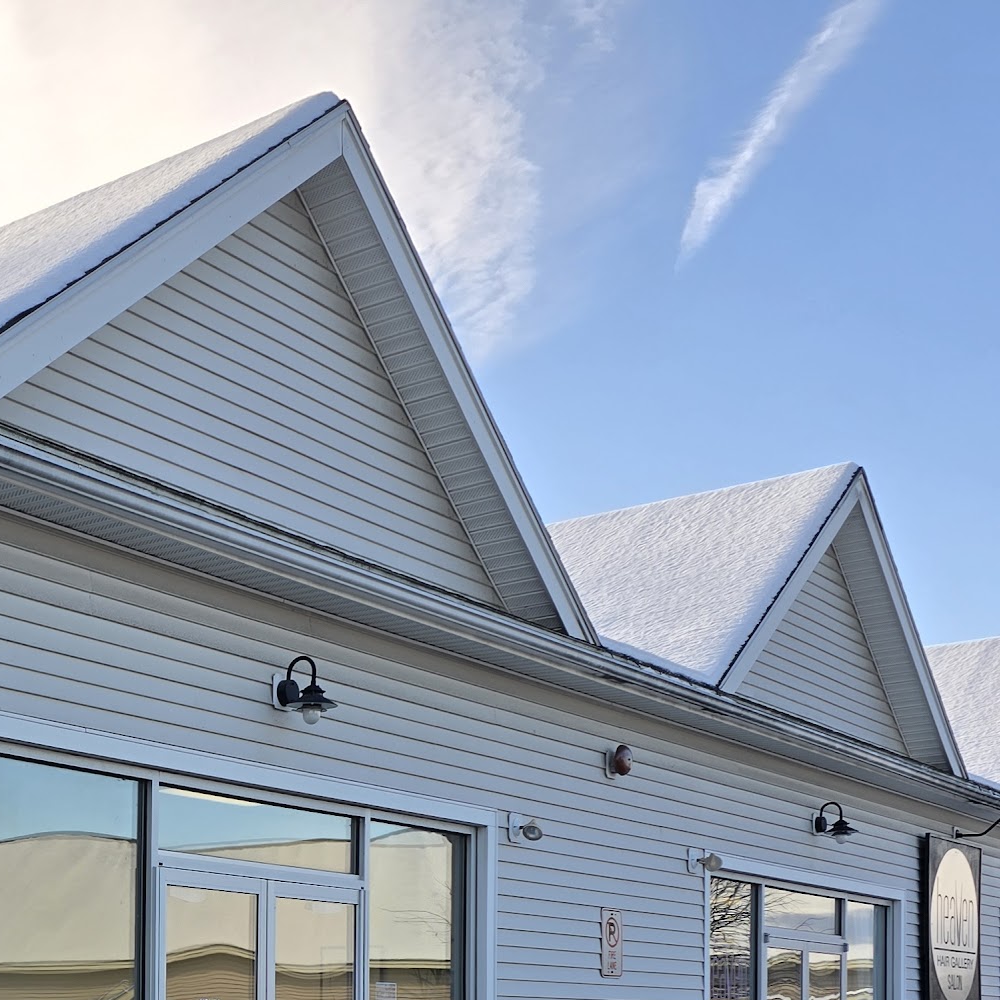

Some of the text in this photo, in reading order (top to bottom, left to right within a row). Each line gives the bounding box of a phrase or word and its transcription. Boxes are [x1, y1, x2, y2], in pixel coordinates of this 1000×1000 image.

[607, 950, 617, 960] FIRE
[607, 961, 617, 971] LANE
[936, 954, 974, 970] HAIR GALLERY
[947, 973, 963, 991] SALON
